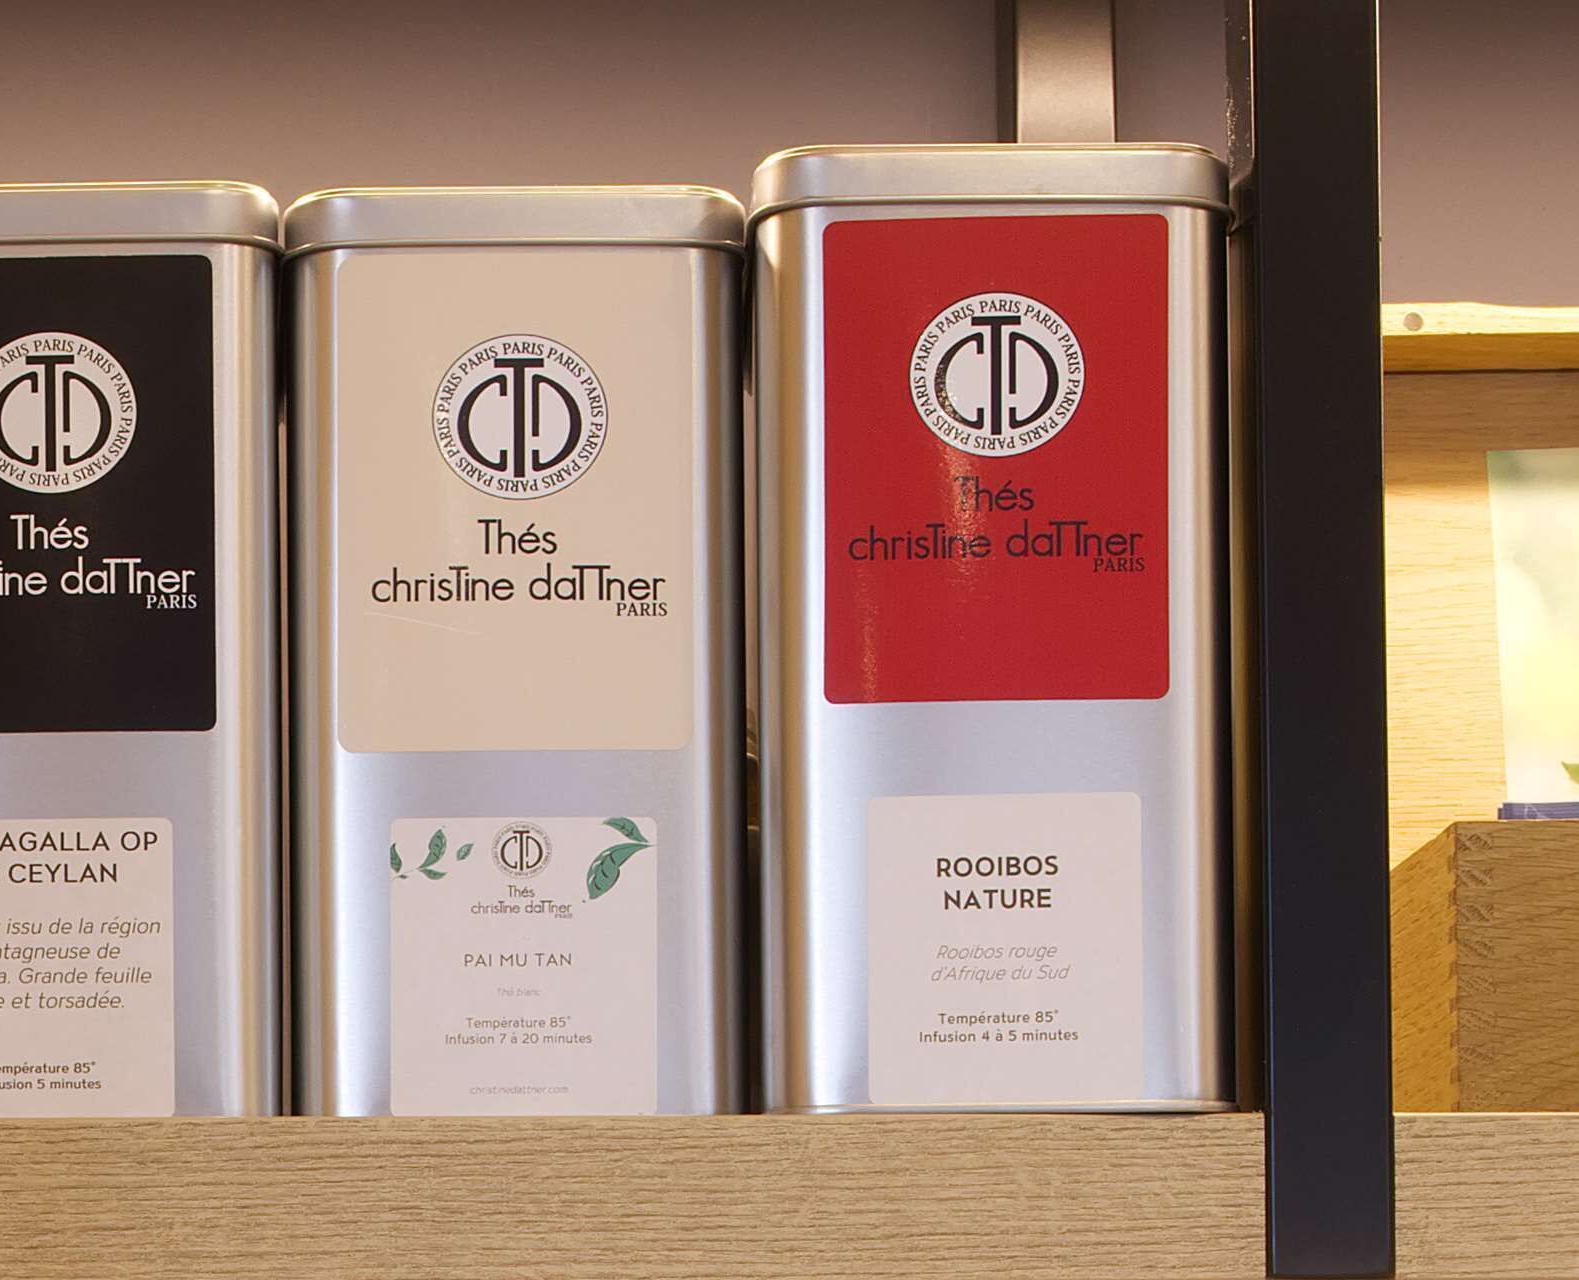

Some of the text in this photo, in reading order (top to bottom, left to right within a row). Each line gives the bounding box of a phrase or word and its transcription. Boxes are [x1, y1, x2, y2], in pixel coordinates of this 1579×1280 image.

[33, 338, 75, 353] PARIS
[76, 343, 115, 374] PARIS
[110, 372, 133, 413] PARIS
[436, 341, 604, 493] PARIS PARIS PARIS PARIS PARIS PARIS PARIS PARIS PARIS PARIS
[107, 417, 133, 457] PARIS
[72, 454, 112, 483] PARIS
[28, 472, 70, 487] PARIS
[9, 514, 89, 550] Thés
[477, 518, 558, 555] Thés
[1093, 557, 1144, 572] PARIS
[146, 595, 197, 609] PARIS
[616, 602, 668, 617] PARIS
[120, 830, 158, 852] OP
[8, 863, 117, 884] CEYLAN
[936, 855, 1059, 878] ROOIBOS
[944, 888, 1052, 911] NATURE
[6, 918, 43, 935] issu
[48, 917, 73, 935] de
[78, 917, 94, 935] la
[100, 915, 161, 939] région
[96, 942, 121, 960] de
[464, 952, 572, 968] PAI MU TAN
[936, 944, 1058, 962] Rooibos rouge
[18, 967, 88, 985] Grande
[94, 966, 153, 984] feuille
[1010, 964, 1033, 981] du
[1038, 962, 1071, 981] Sud
[11, 991, 33, 1010] et
[466, 1016, 546, 1029] Température
[937, 1010, 1031, 1027] Température
[445, 1033, 494, 1045] Infusion
[522, 1033, 539, 1044] 20
[543, 1032, 592, 1044] minutes
[919, 1030, 977, 1043] Infusion
[1021, 1028, 1079, 1041] minutes
[36, 1078, 46, 1090] 5
[49, 1078, 102, 1090] minutes
